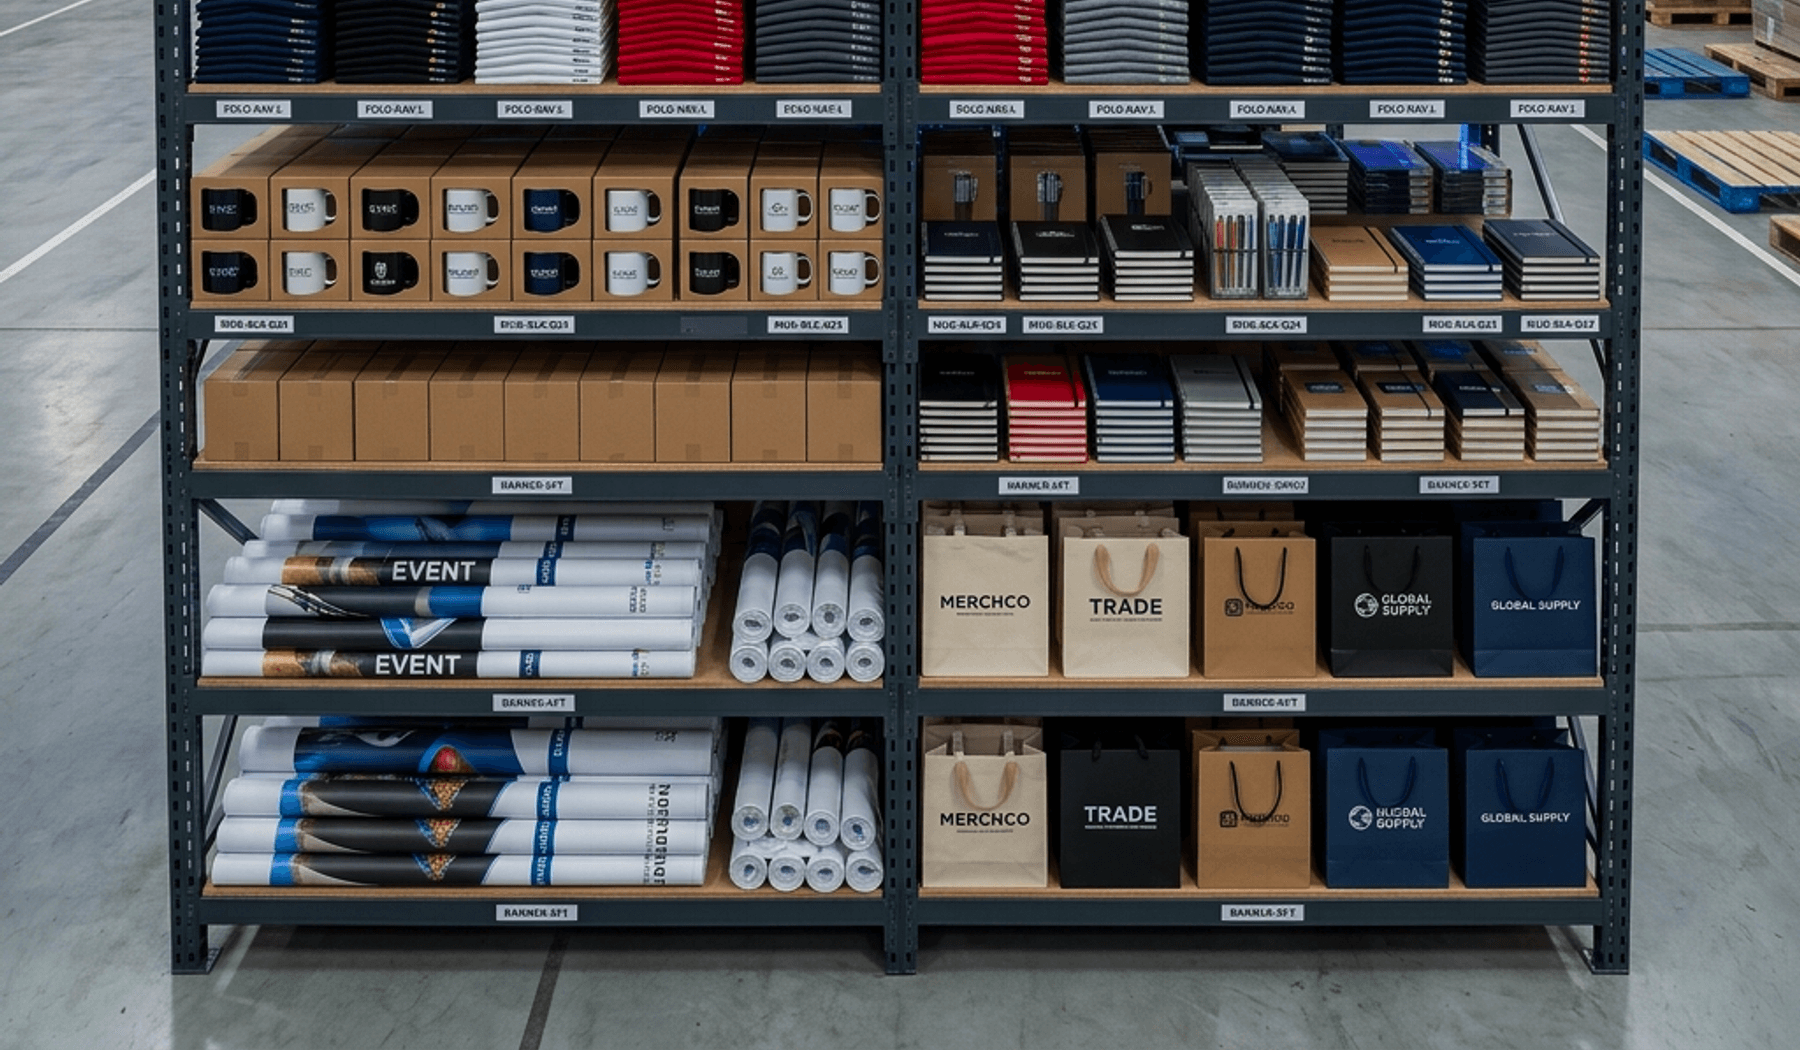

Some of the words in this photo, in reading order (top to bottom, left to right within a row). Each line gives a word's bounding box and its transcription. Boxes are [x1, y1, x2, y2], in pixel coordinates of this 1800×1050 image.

[392, 560, 476, 581] EVENT
[940, 594, 1031, 609] MERCHCO
[1089, 598, 1163, 615] TRADE
[1381, 594, 1432, 605] GLOBAL
[1538, 600, 1581, 610] SUPPLY
[1382, 605, 1432, 616] SUPPLY
[375, 654, 462, 675] EVENT
[1084, 805, 1157, 823] TRADE
